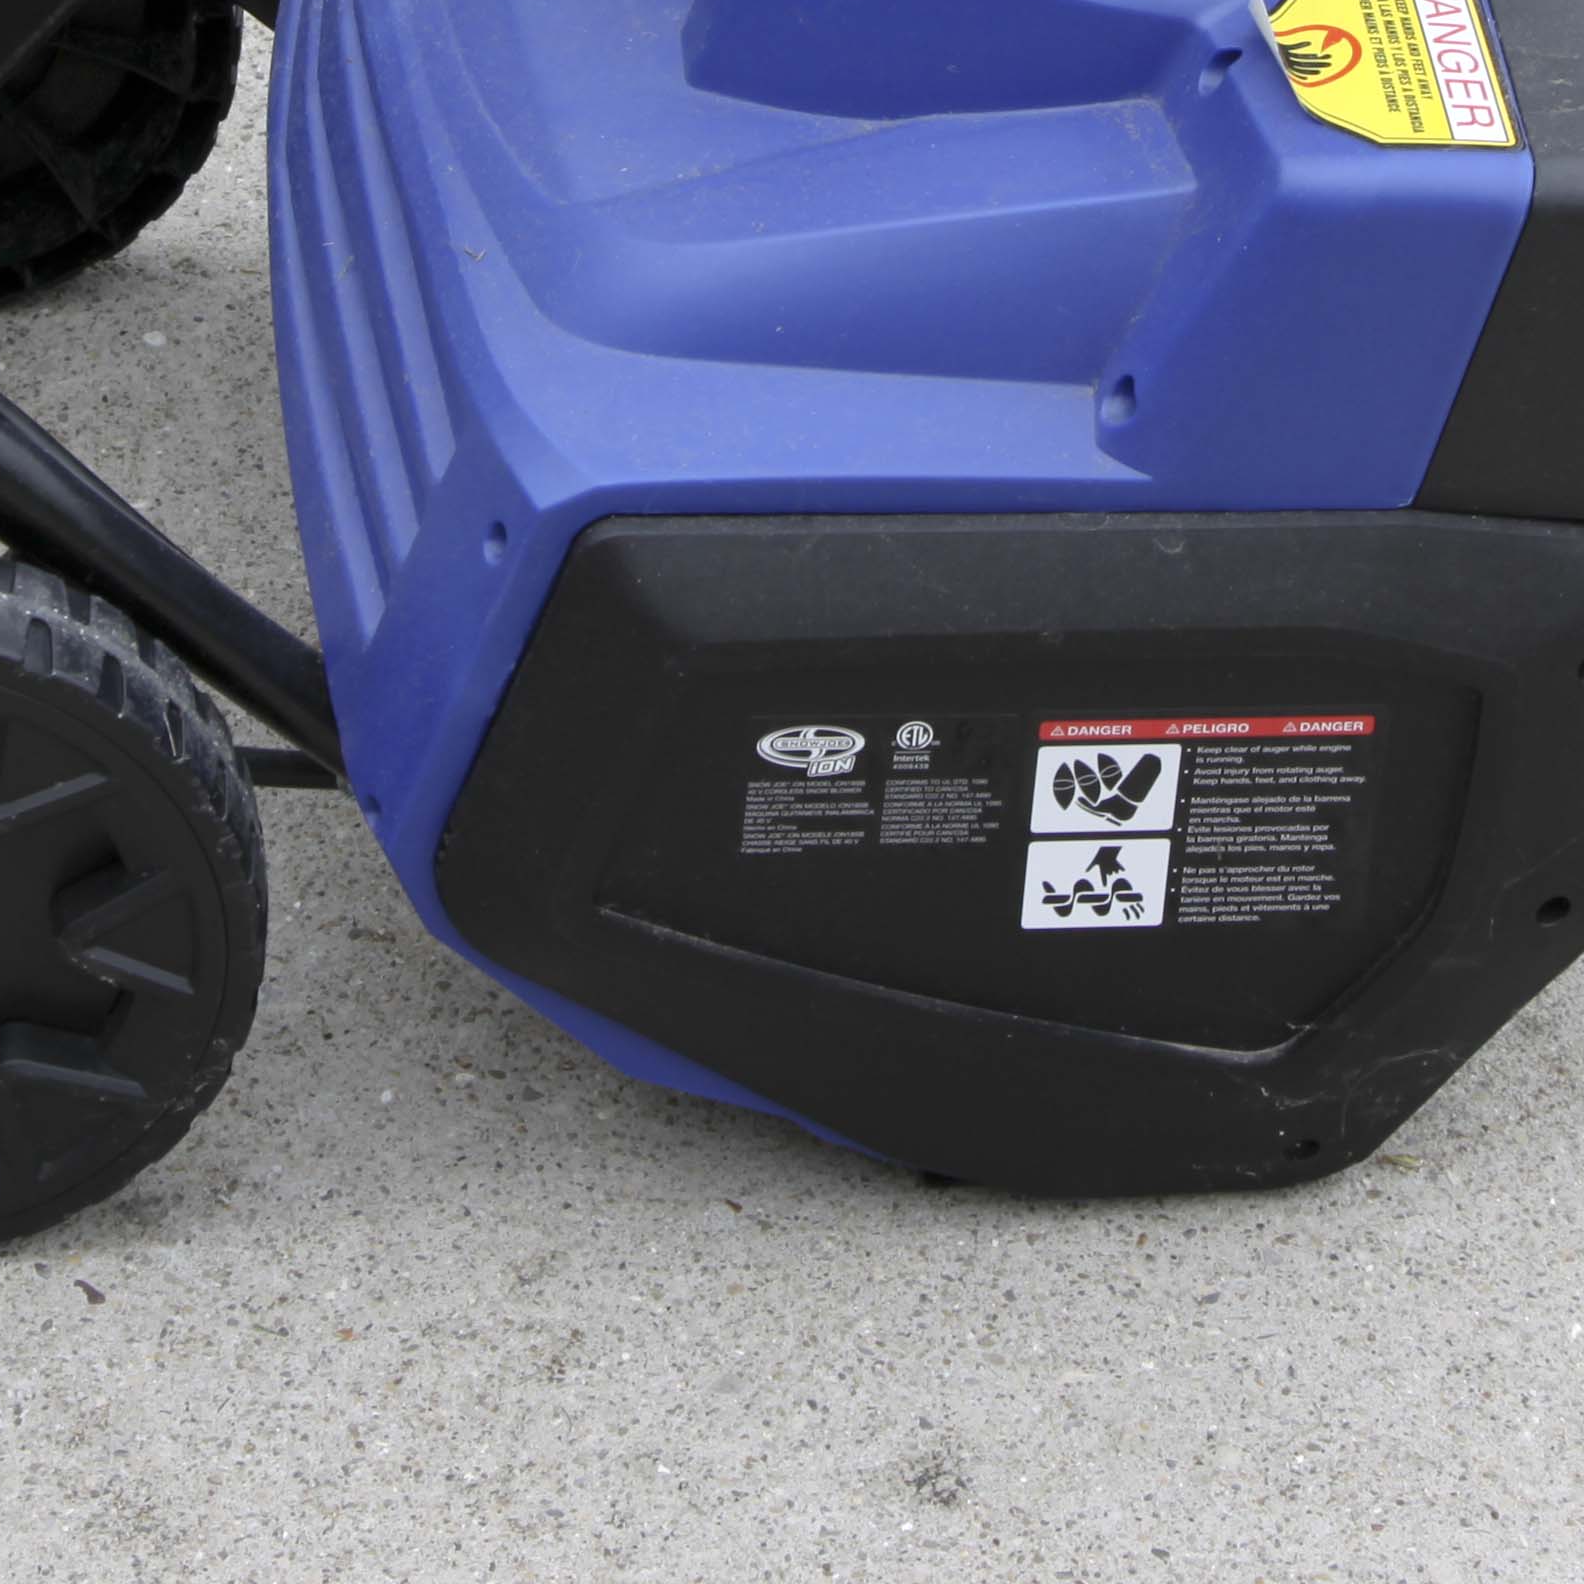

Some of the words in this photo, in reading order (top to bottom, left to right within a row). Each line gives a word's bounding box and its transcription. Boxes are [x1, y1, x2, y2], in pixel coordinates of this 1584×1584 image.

[1379, 4, 1392, 18] LAS
[1363, 13, 1379, 34] MAINS
[1400, 17, 1417, 40] HANDS
[1384, 20, 1400, 44] MANOS
[1370, 37, 1382, 45] ET
[1408, 43, 1421, 57] AND
[1372, 47, 1389, 69] PIEDS
[1392, 53, 1406, 67] LOS
[1413, 59, 1427, 76] FEET
[1397, 69, 1412, 85] PIES
[1381, 77, 1400, 112] DISTANCE
[1418, 79, 1433, 99] AWAY
[1404, 95, 1424, 133] DISTANCIA
[1067, 724, 1132, 736] DANGER
[1182, 723, 1250, 734] PELIGRO
[1299, 721, 1363, 732] DANGER
[1197, 746, 1221, 754] Keep
[1250, 745, 1261, 753] of
[1262, 746, 1289, 754] auger
[1319, 745, 1351, 753] engine
[893, 754, 930, 763] Intertek
[1224, 767, 1249, 776] injury
[1276, 767, 1313, 775] rotating
[1299, 776, 1337, 784] clothing
[1252, 796, 1286, 804] alejado
[1255, 825, 1311, 833] provocadas
[1236, 835, 1278, 843] giratoria.
[1281, 834, 1328, 842] Mantenga
[1212, 906, 1238, 914] pieds
